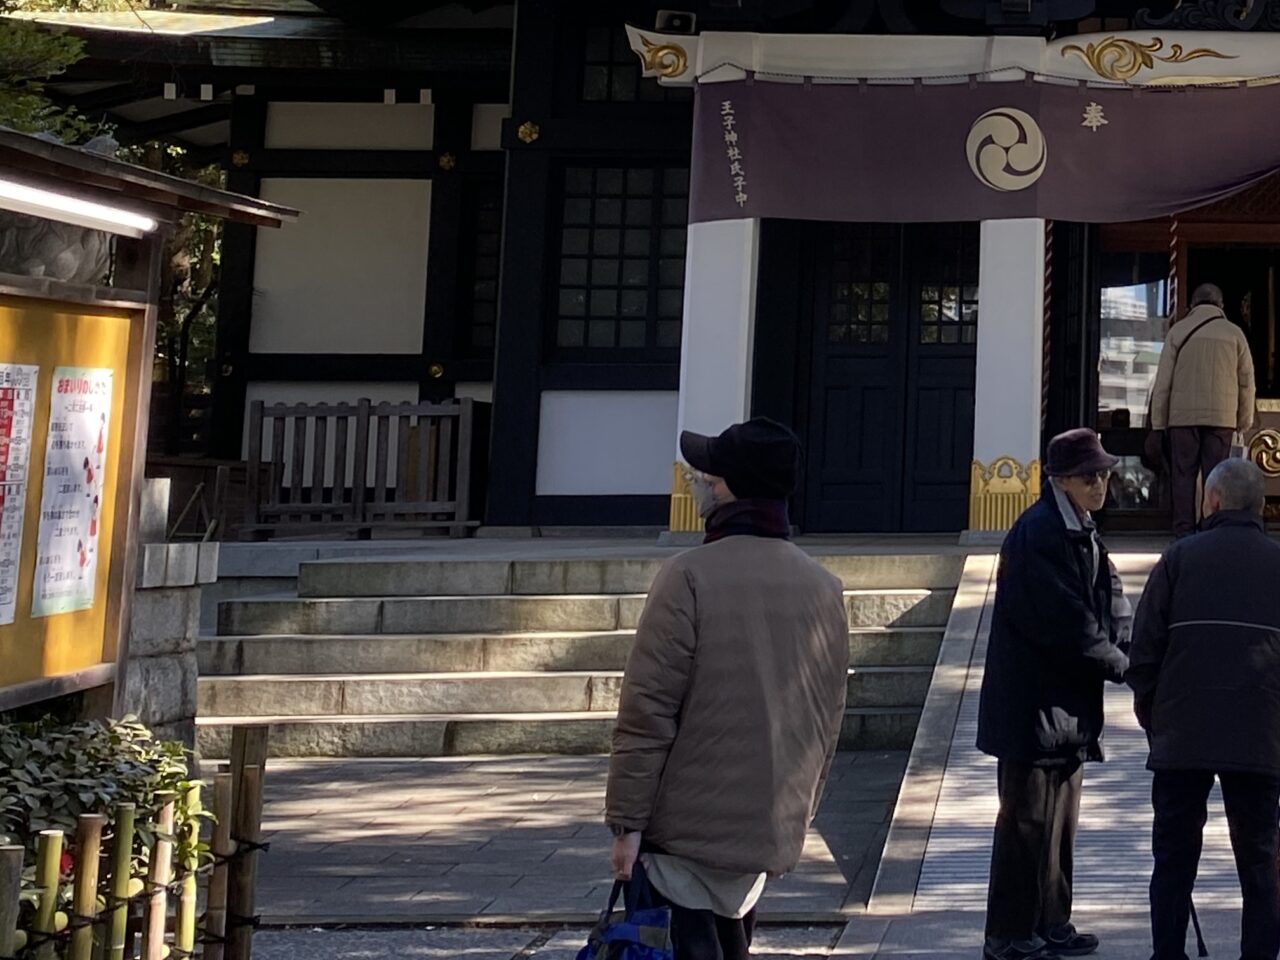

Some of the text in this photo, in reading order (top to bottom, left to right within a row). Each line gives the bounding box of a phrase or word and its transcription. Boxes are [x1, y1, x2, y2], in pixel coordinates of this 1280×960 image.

[1081, 101, 1109, 132] 奉
[721, 100, 748, 208] 王子神社氏子中
